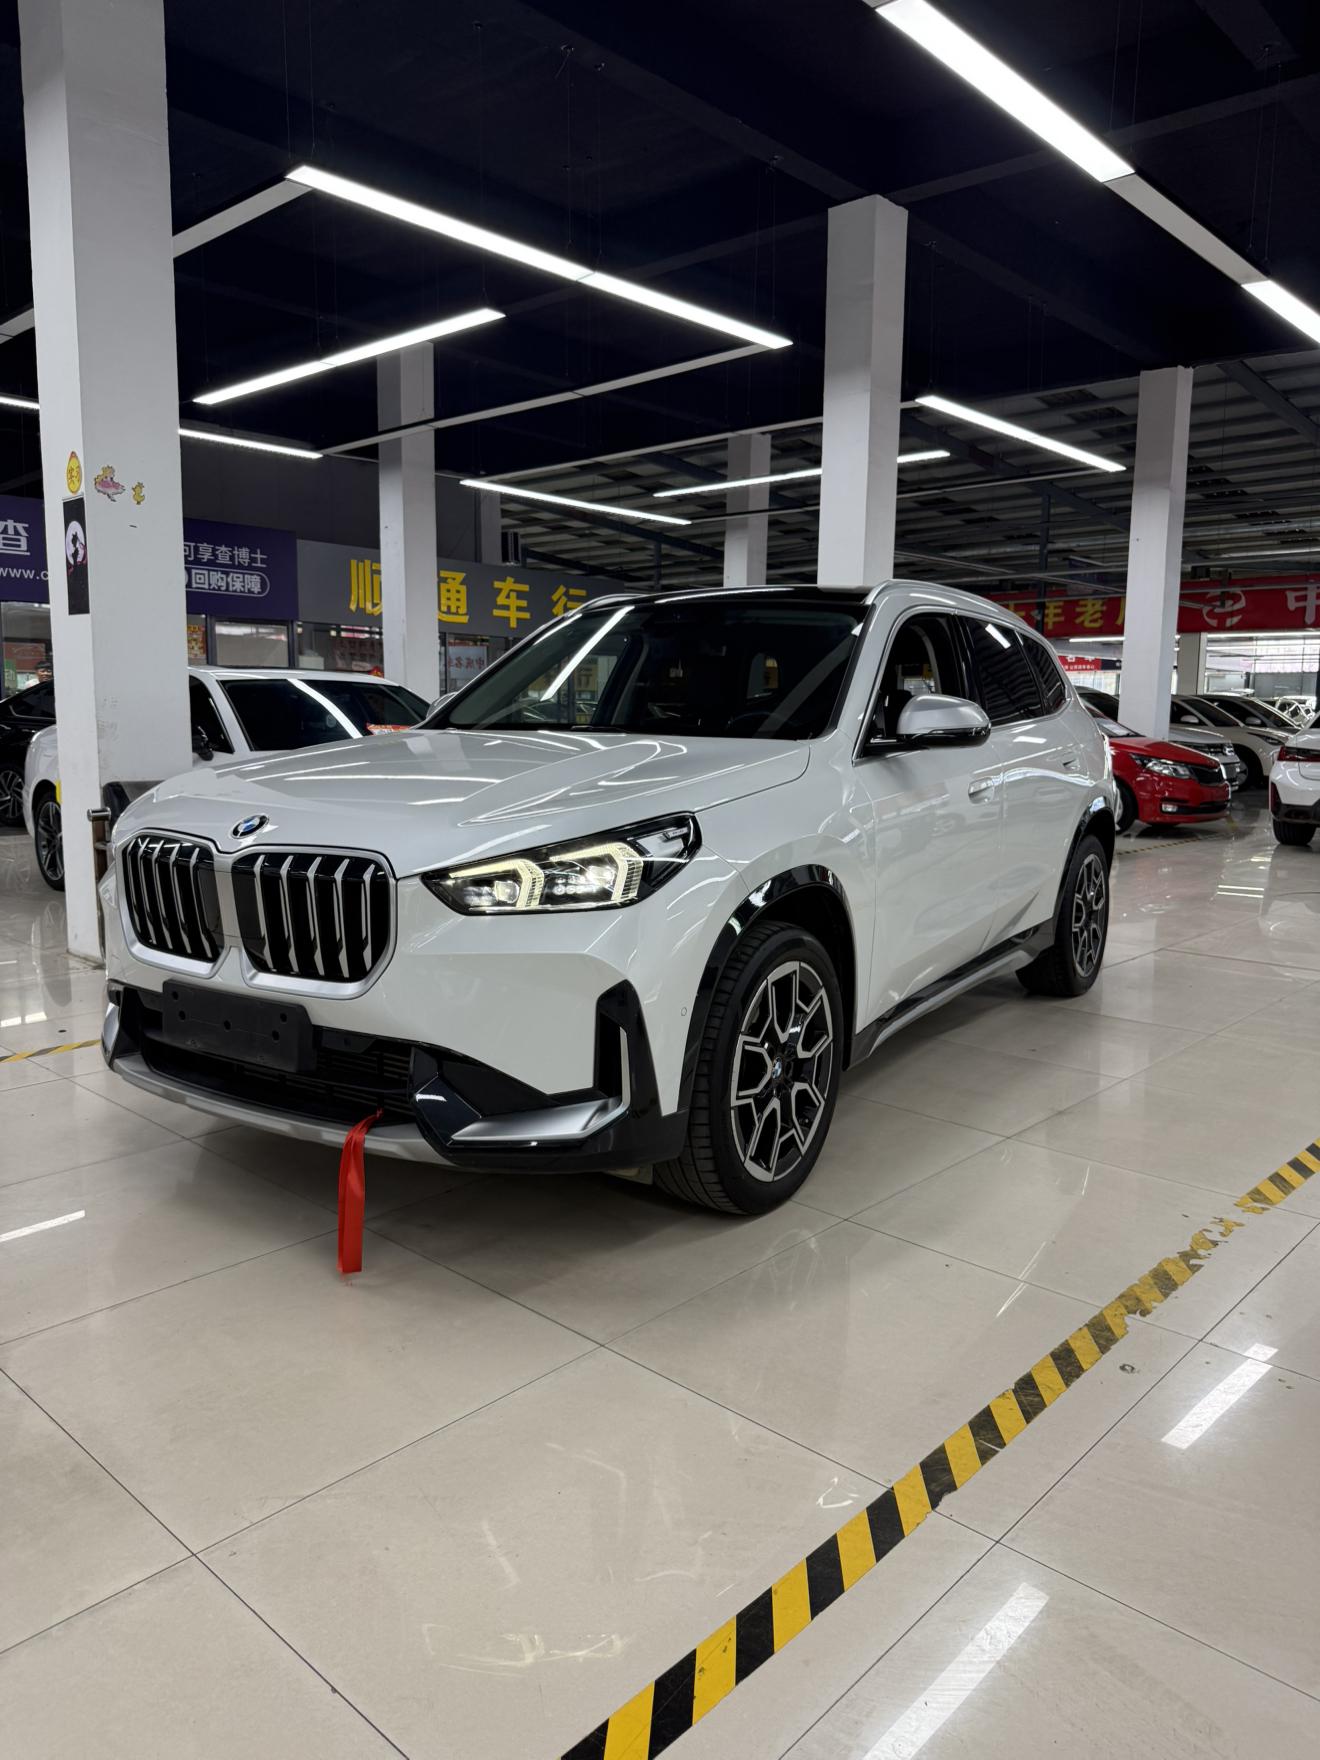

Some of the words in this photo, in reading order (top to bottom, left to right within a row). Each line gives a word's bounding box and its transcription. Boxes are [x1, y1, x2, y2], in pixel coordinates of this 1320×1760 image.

[0, 519, 31, 556] 查
[183, 541, 268, 568] 可享查博士
[191, 568, 263, 594] 回购保障
[1008, 597, 1125, 630] 年老
